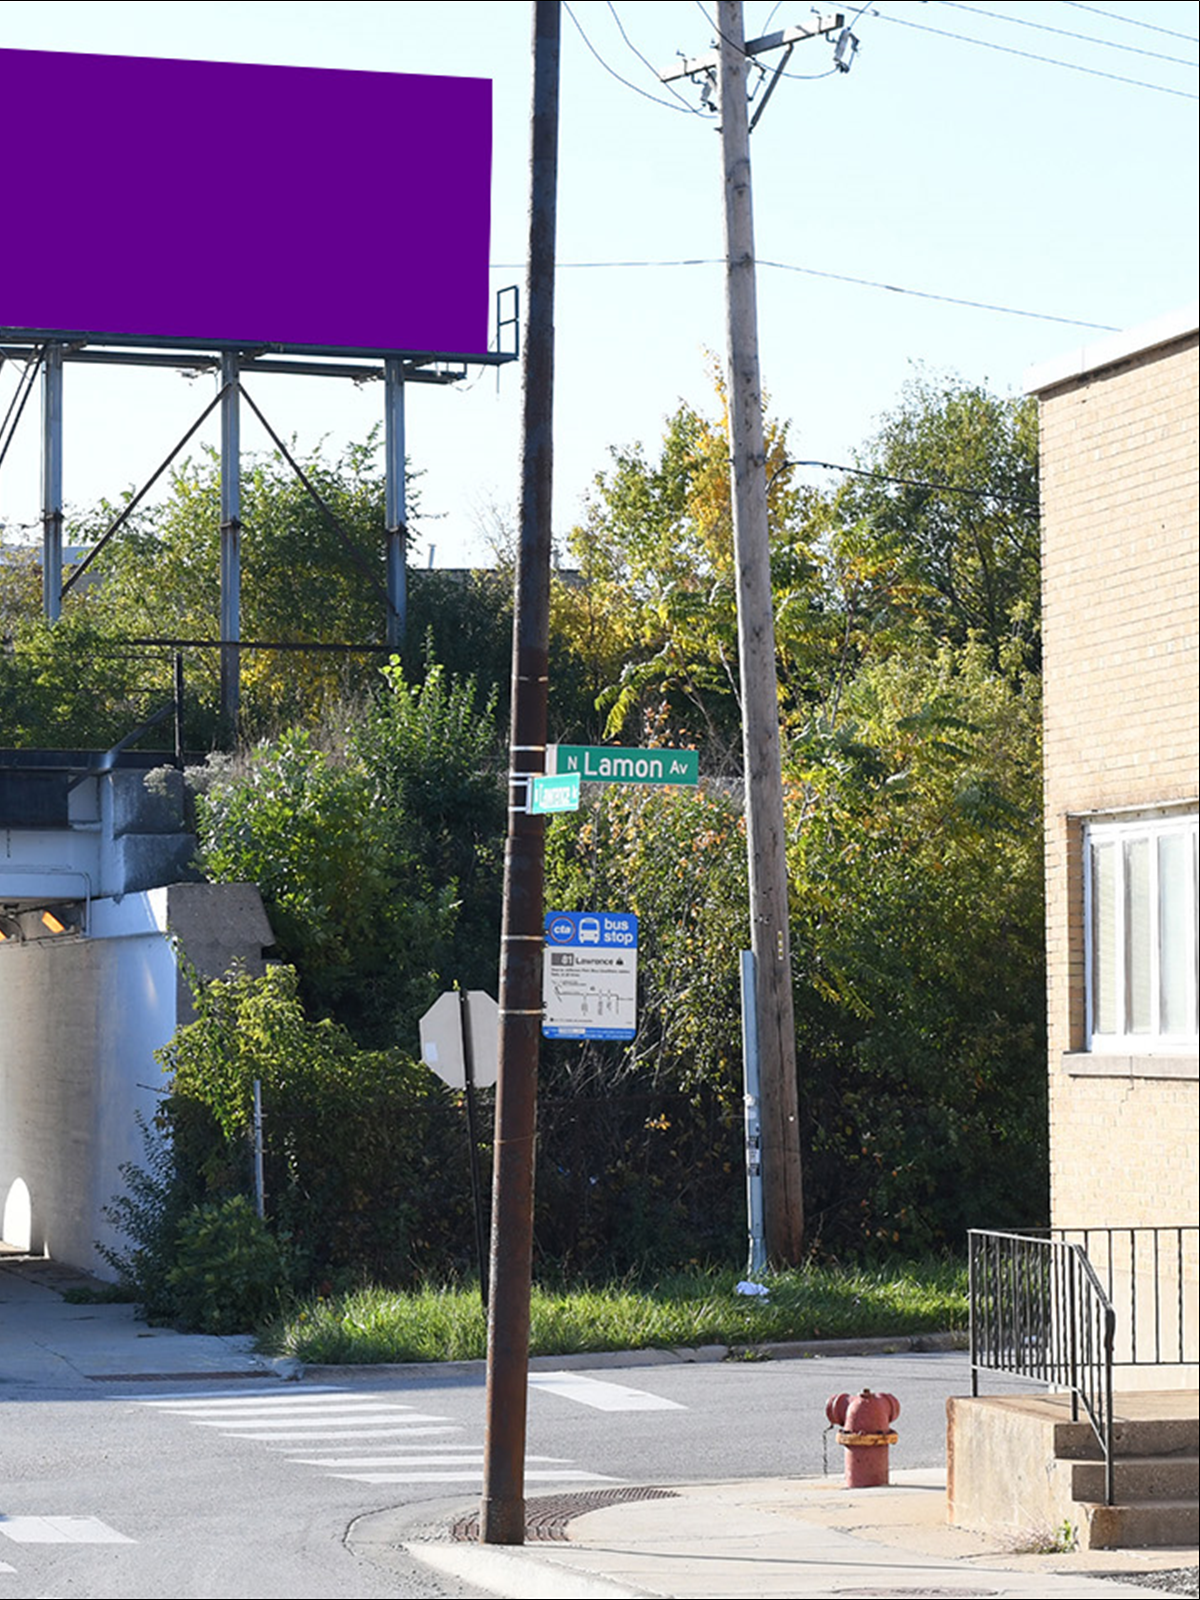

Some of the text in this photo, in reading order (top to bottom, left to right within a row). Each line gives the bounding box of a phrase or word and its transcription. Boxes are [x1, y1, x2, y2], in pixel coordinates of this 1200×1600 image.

[567, 751, 688, 778] N Lamon Av
[554, 925, 572, 934] cta
[604, 918, 629, 930] bus
[604, 931, 634, 946] stop
